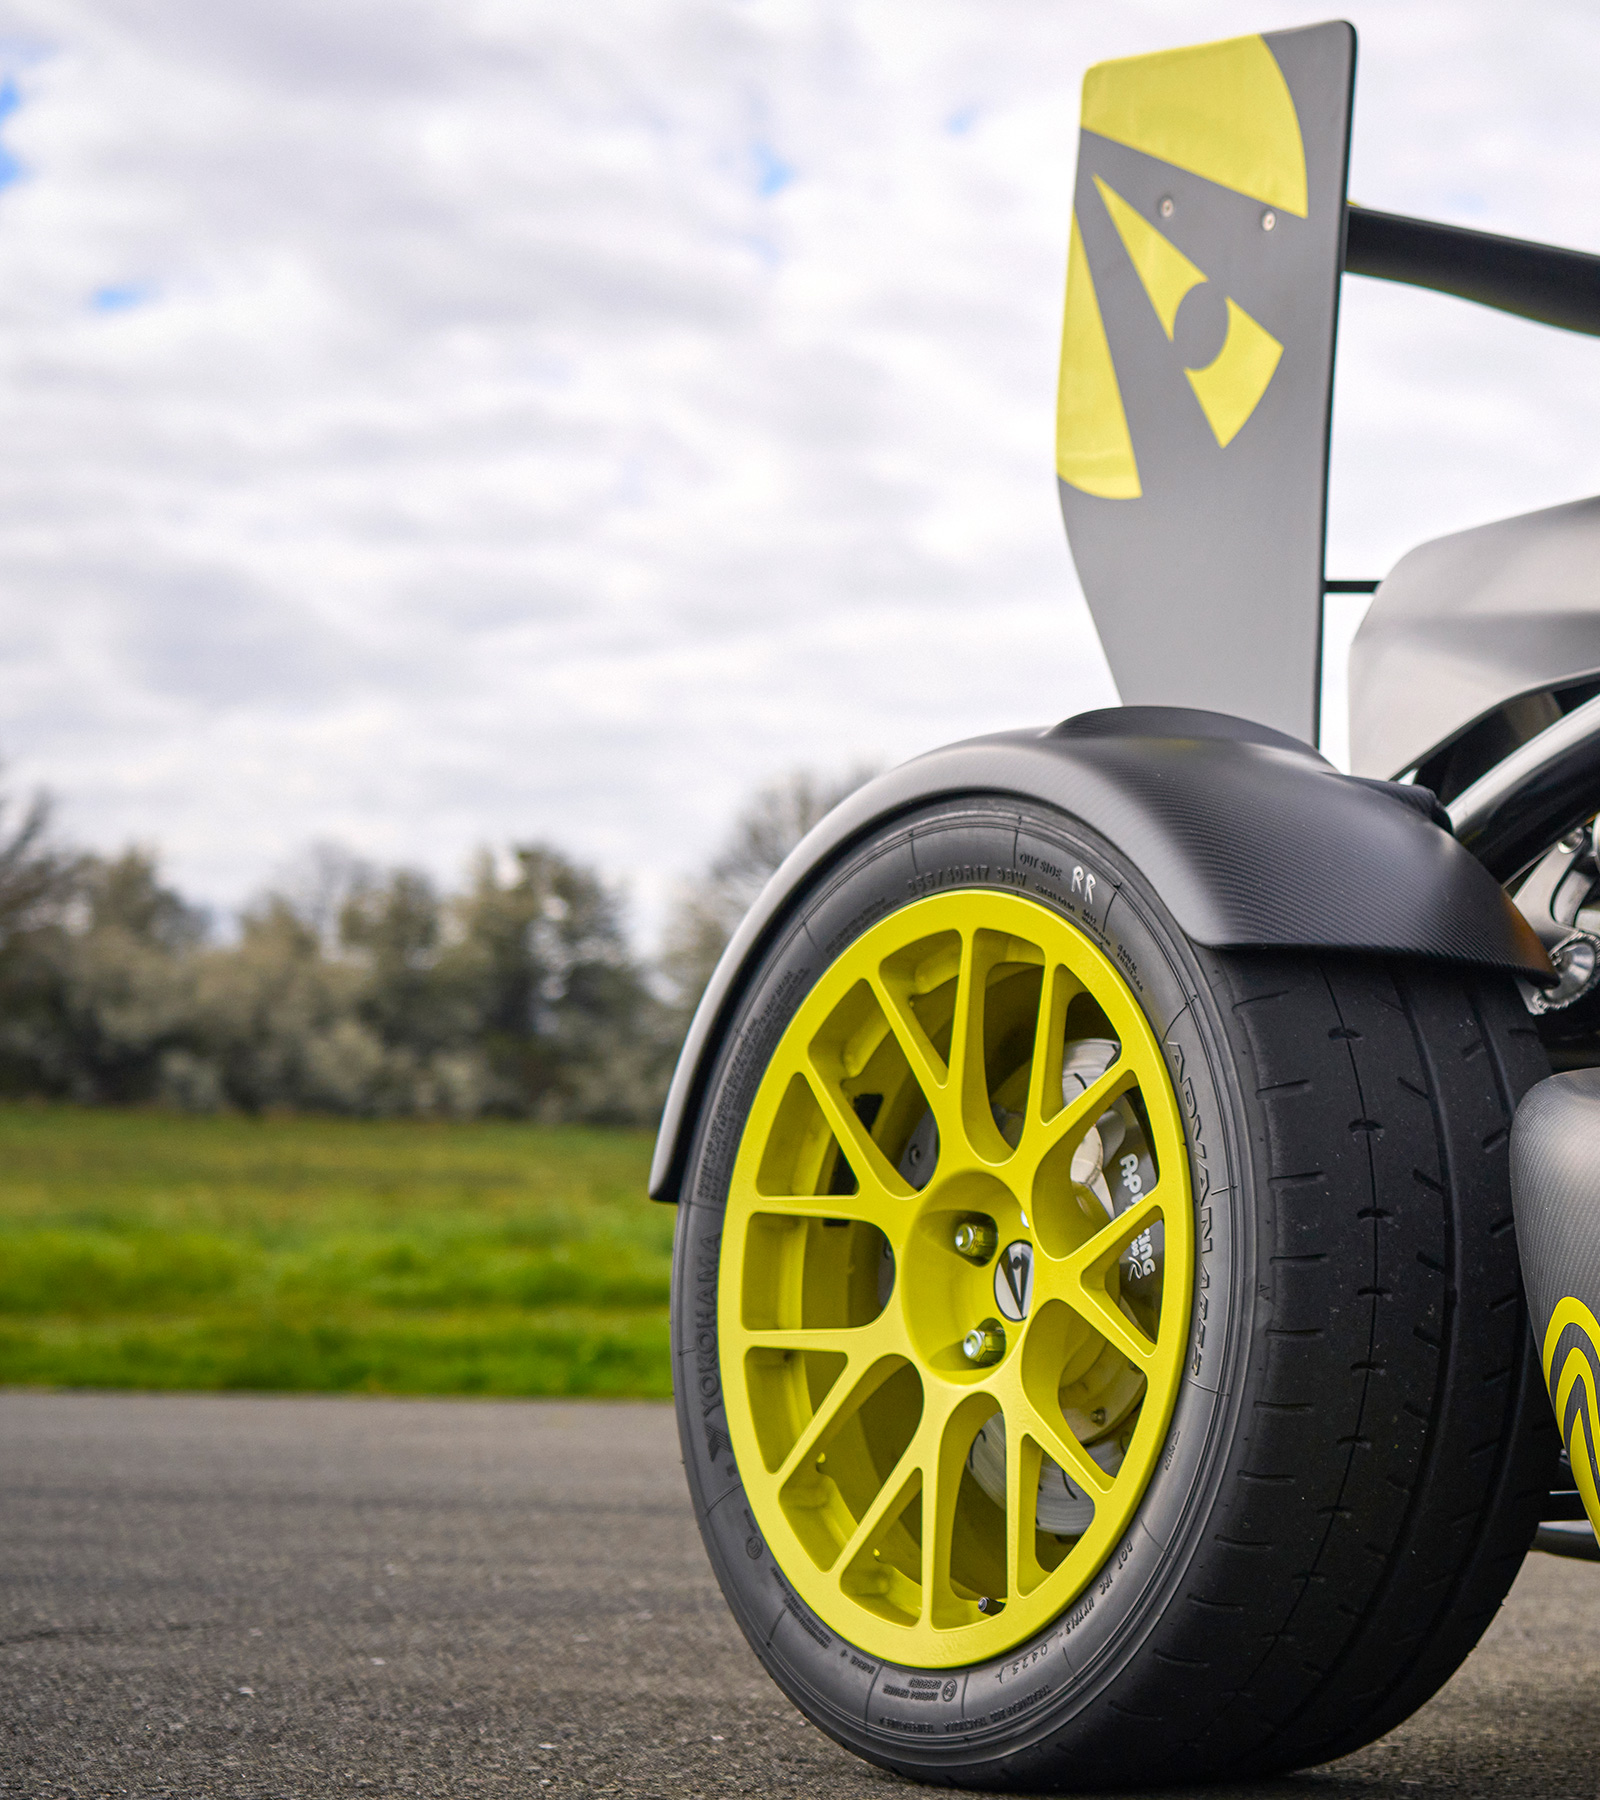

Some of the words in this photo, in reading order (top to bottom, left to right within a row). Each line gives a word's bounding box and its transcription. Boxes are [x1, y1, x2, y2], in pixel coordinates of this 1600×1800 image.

[1071, 865, 1097, 904] RR
[1119, 1153, 1143, 1194] AP
[1167, 1041, 1212, 1253] ADVAN
[696, 1230, 721, 1418] YOKOHAMA
